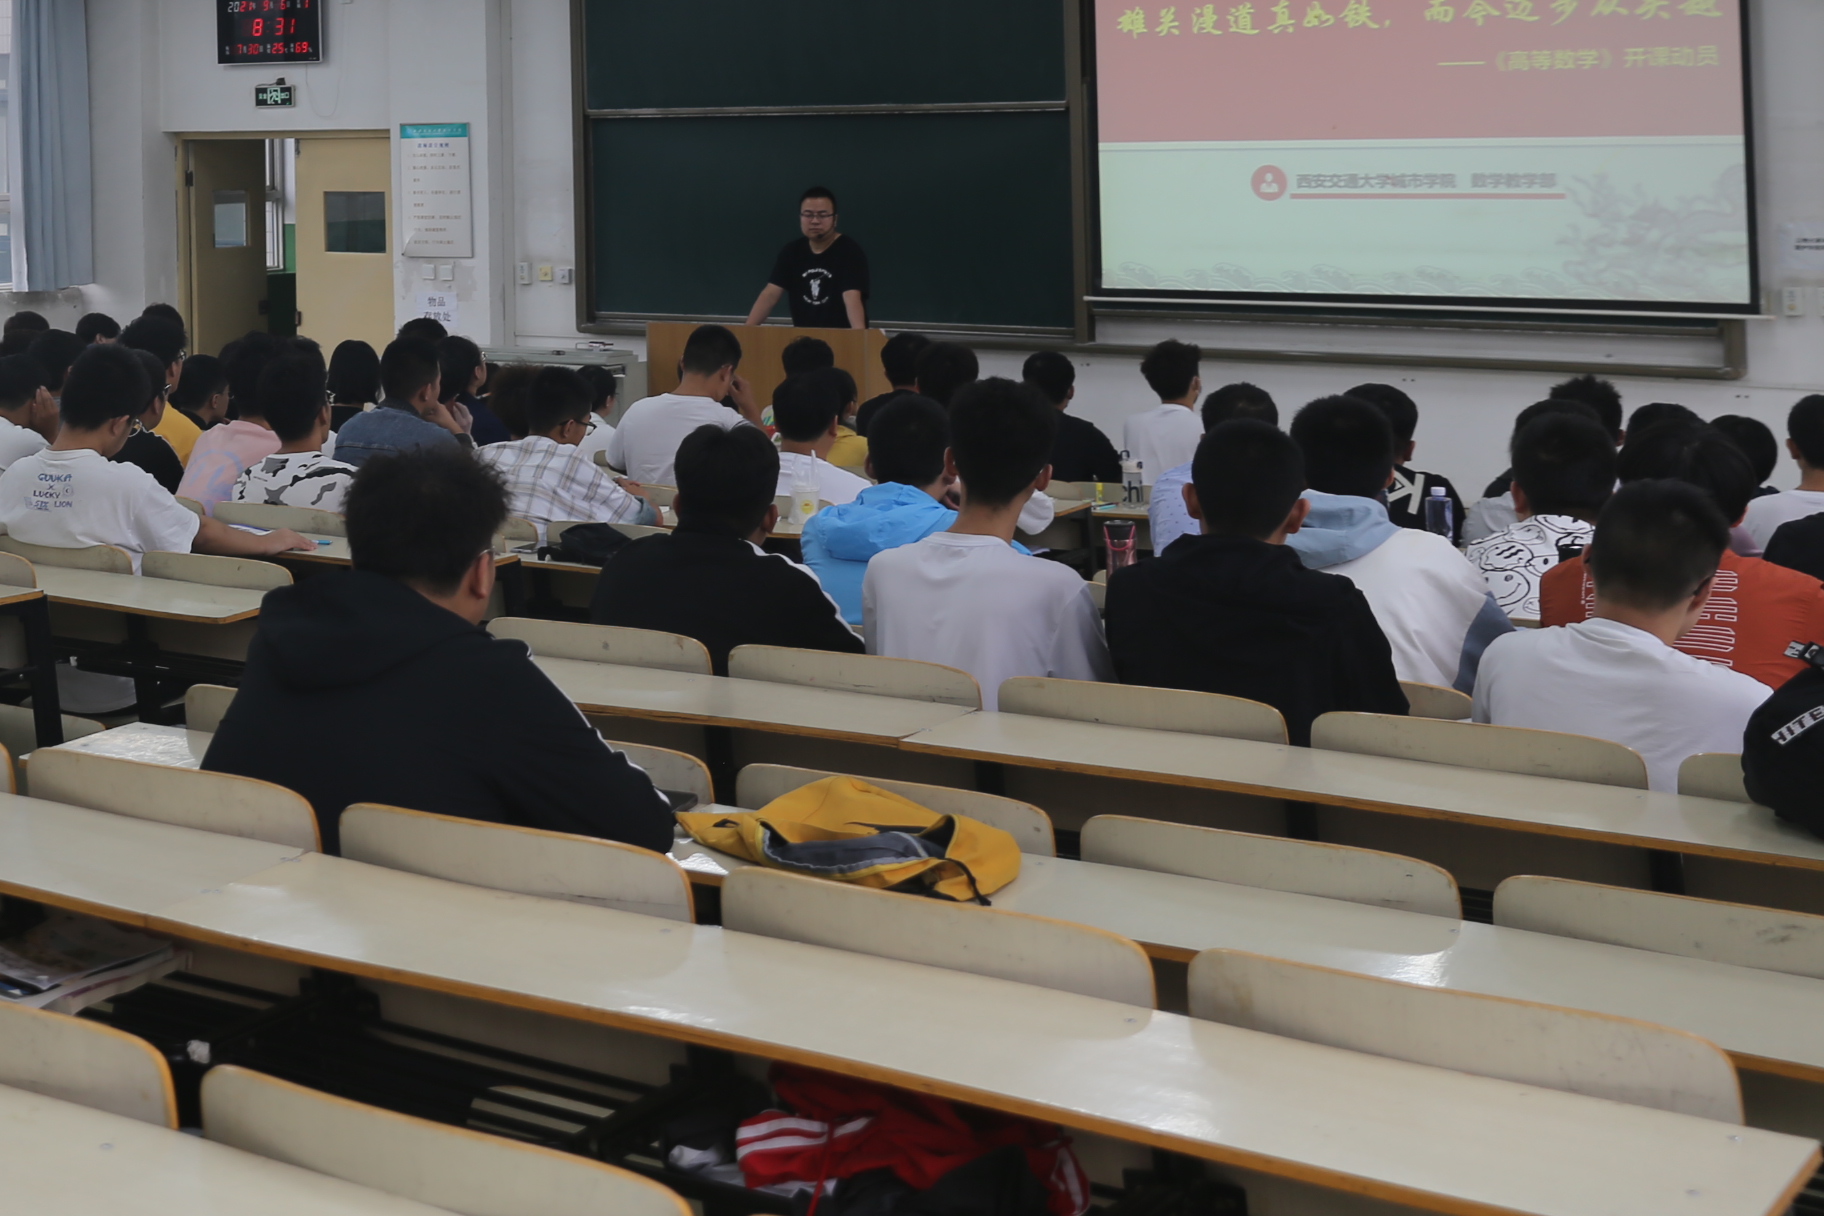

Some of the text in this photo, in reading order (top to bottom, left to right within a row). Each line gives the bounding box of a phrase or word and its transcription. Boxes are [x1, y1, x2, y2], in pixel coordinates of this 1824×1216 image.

[252, 17, 296, 36] 8:31
[427, 296, 446, 308] 物品
[33, 490, 61, 499] LUCKY
[54, 500, 73, 508] LION
